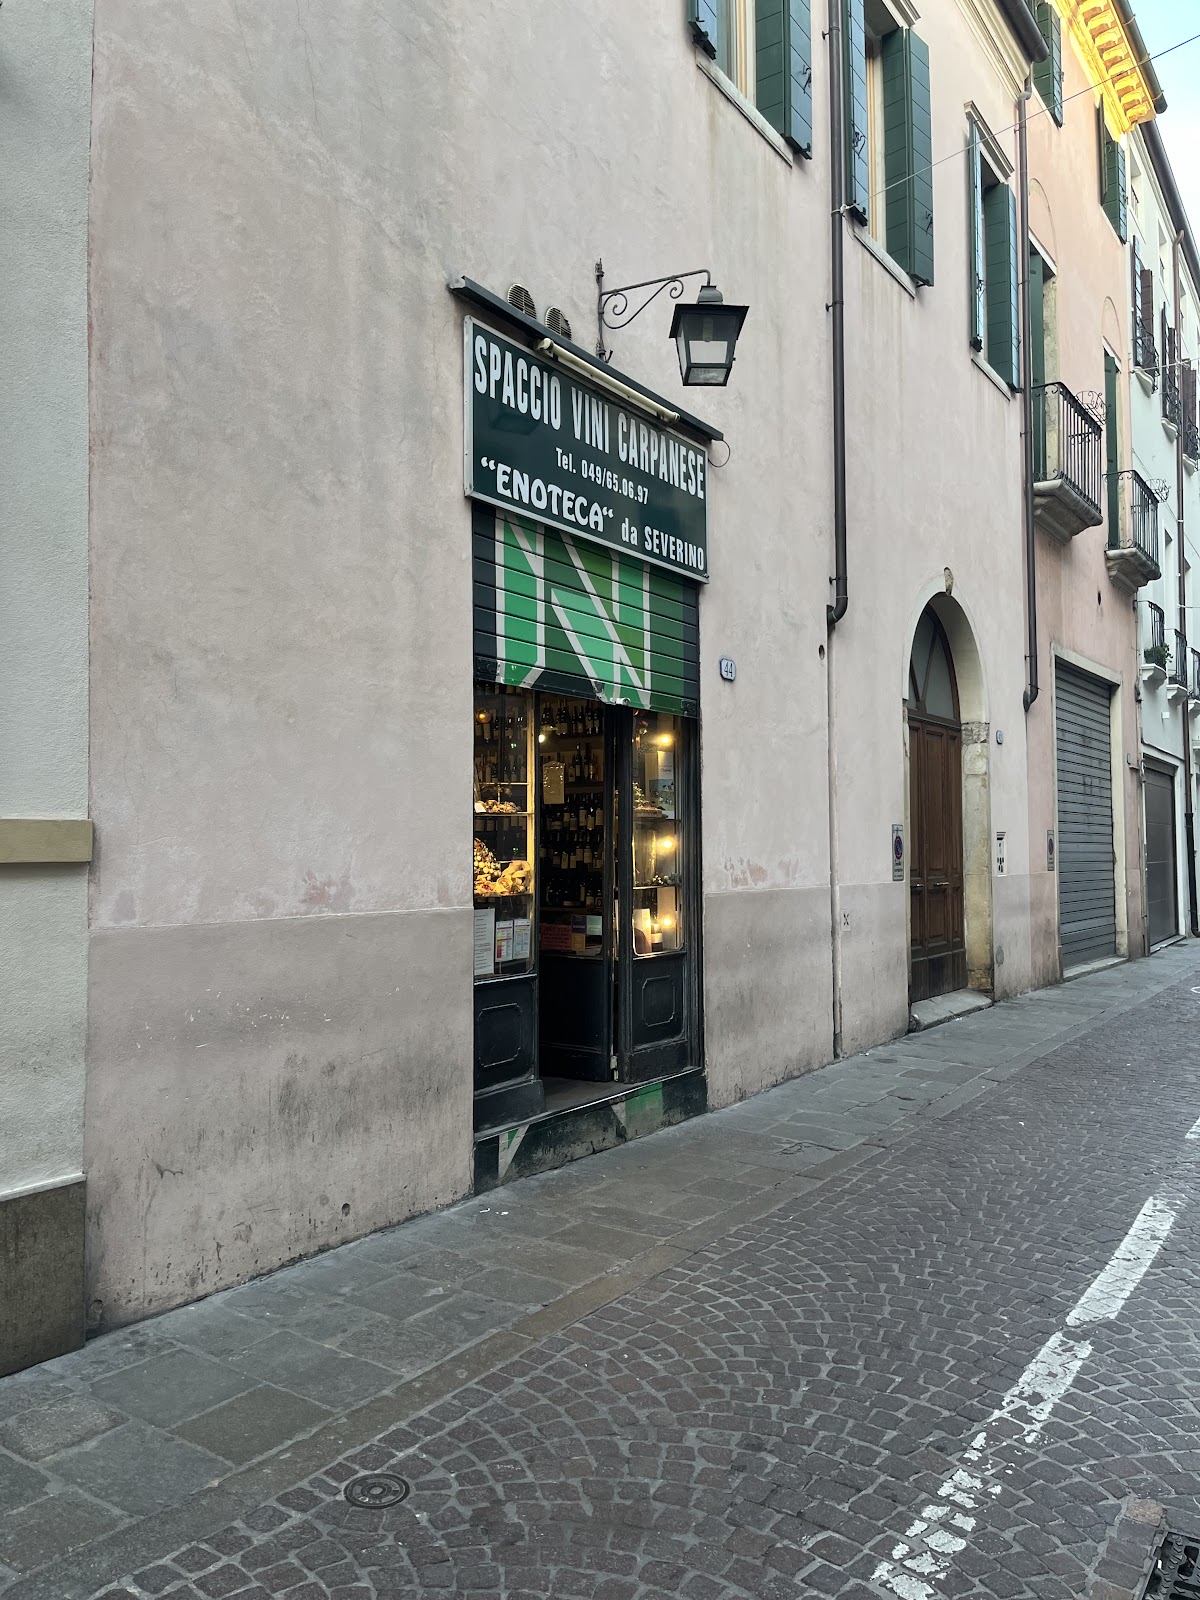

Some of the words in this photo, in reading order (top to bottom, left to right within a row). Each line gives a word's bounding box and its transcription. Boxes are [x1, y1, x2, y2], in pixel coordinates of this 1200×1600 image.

[474, 334, 561, 431] SPACCIO
[571, 386, 610, 454] VINI
[618, 412, 705, 500] CARPANESE
[555, 447, 577, 474] Tel.
[581, 459, 650, 505] 049/65.06.97
[621, 518, 638, 546] da
[644, 526, 705, 571] SEVERINO
[723, 661, 733, 678] 44
